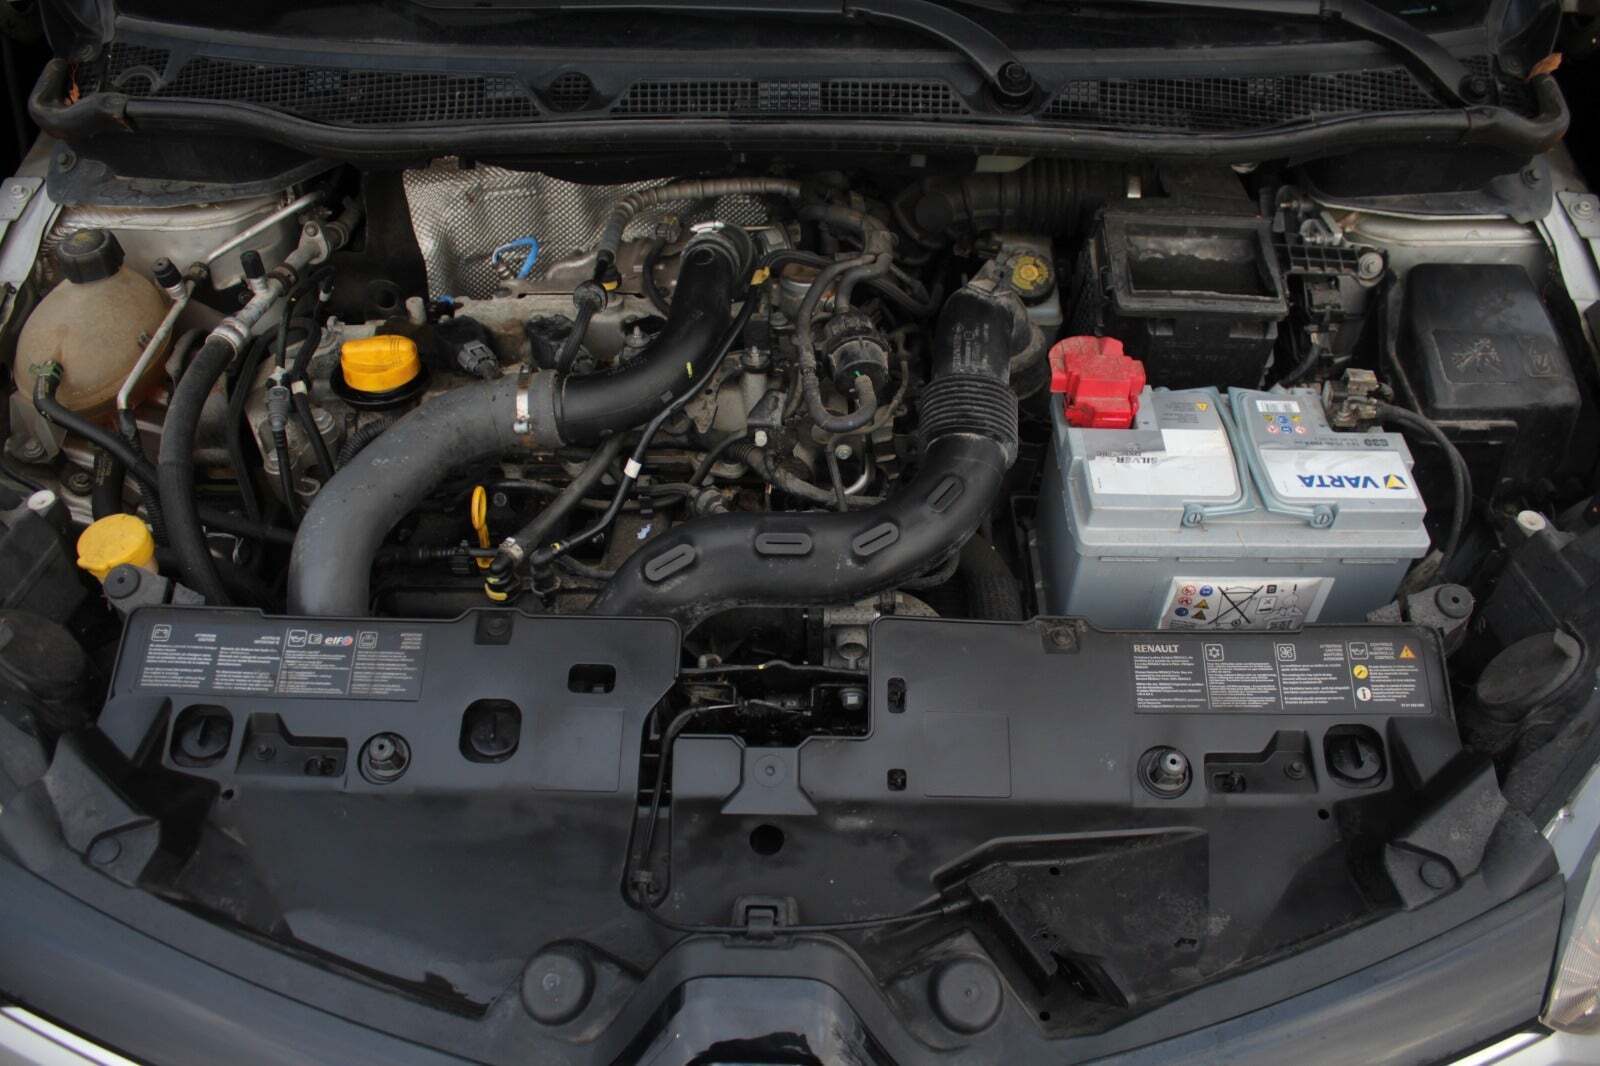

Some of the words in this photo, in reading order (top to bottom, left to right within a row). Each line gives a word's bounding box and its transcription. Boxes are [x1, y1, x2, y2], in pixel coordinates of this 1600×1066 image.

[1116, 456, 1158, 465] SILVER
[1297, 475, 1379, 489] VARTA
[325, 635, 345, 646] elf
[1133, 644, 1179, 653] RENAULT
